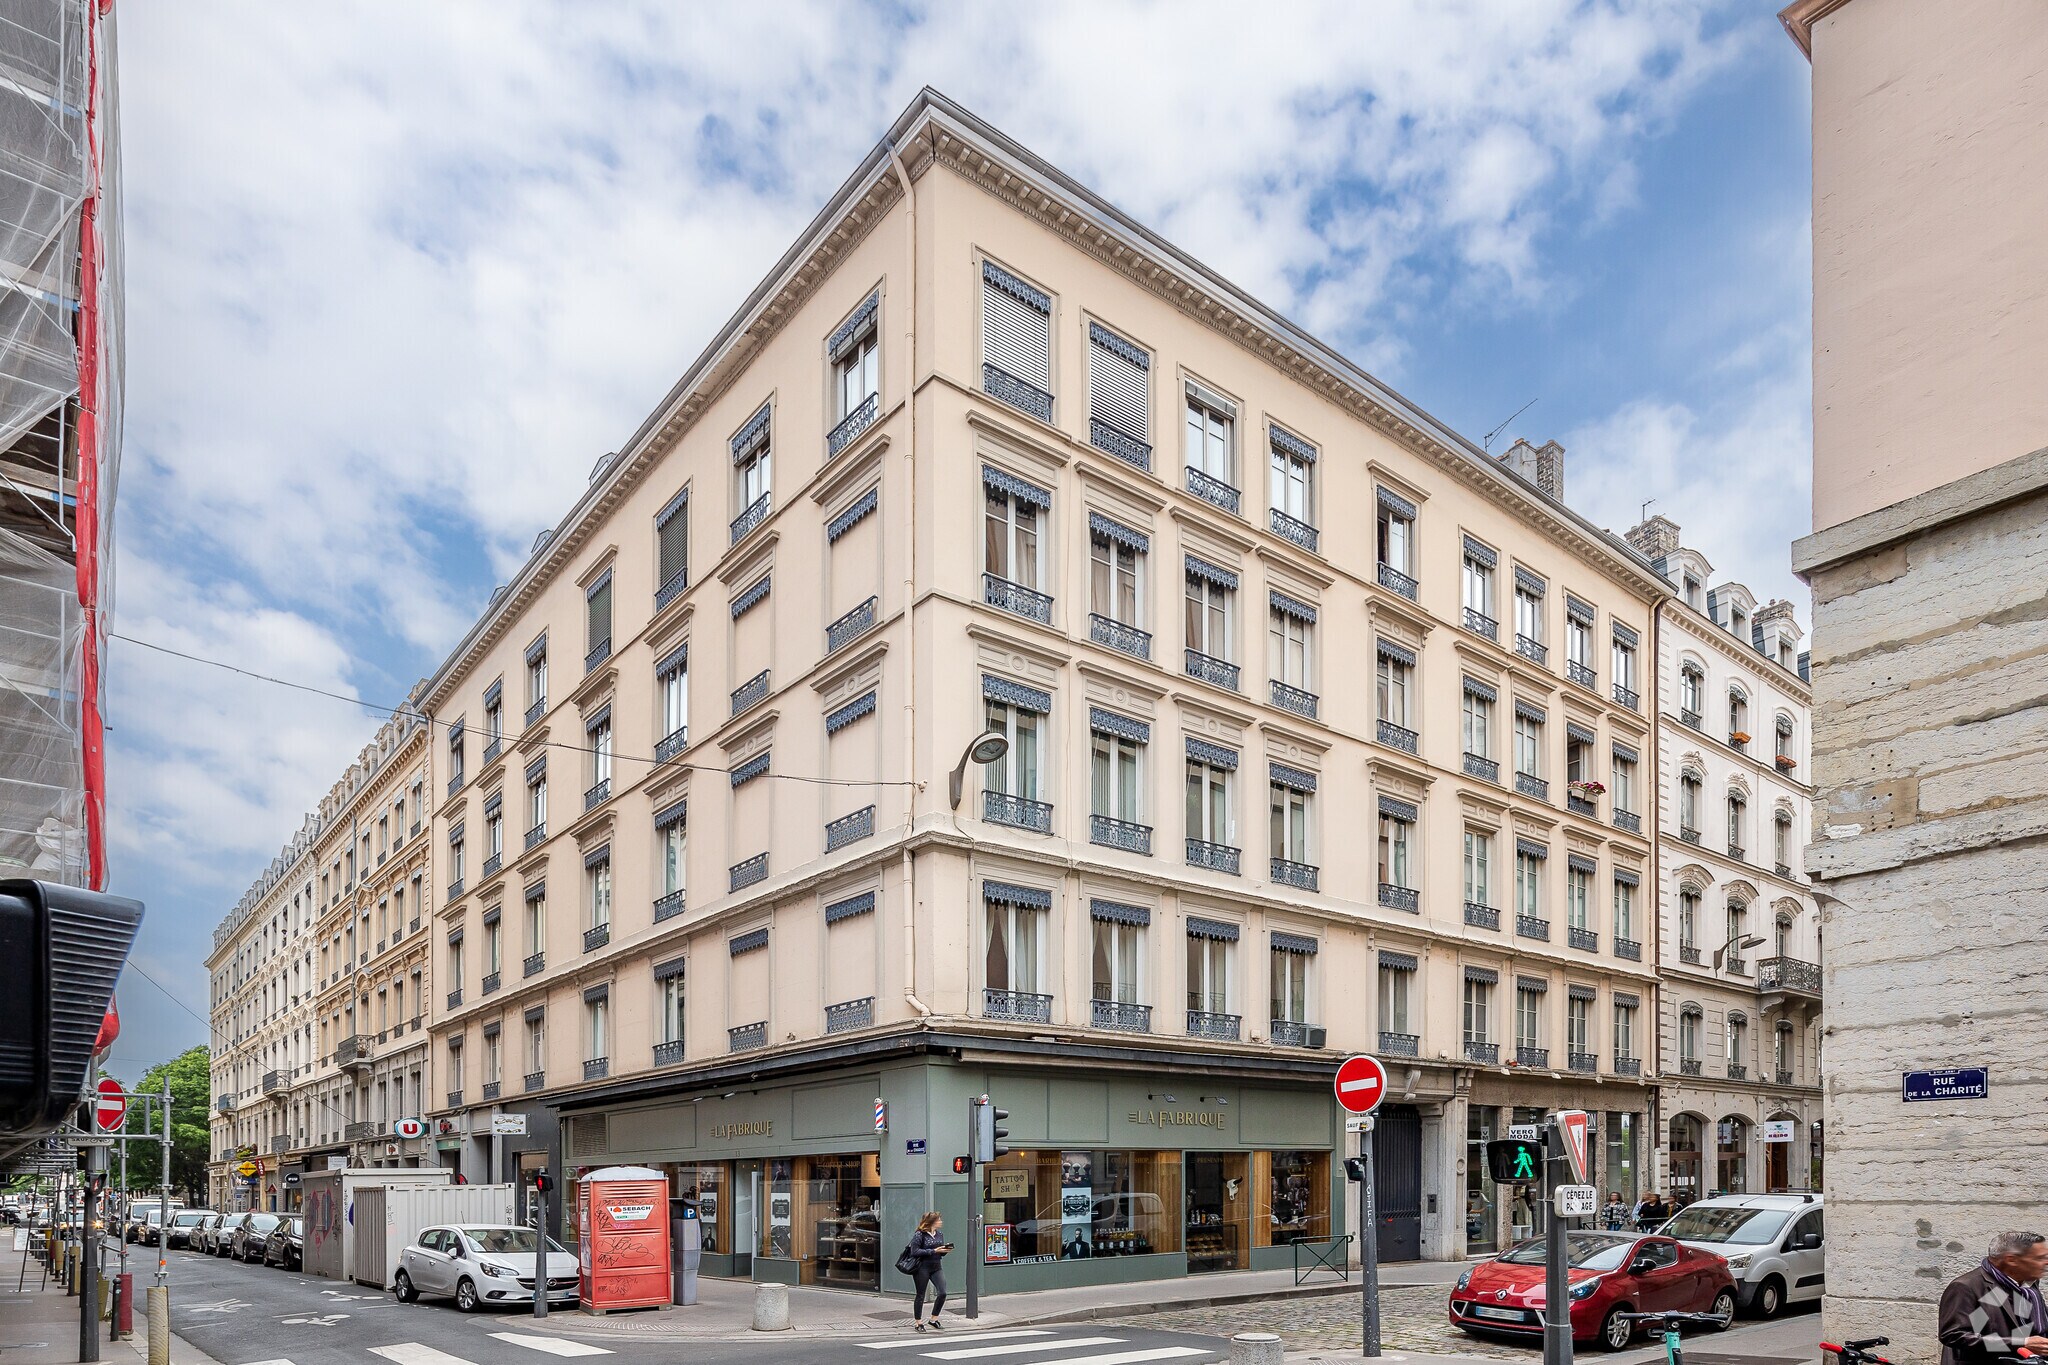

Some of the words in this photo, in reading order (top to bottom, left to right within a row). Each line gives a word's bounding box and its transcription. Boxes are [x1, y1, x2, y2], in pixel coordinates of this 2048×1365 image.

[1933, 1077, 1955, 1086] RUE
[1934, 1084, 1983, 1096] CHARITÉ
[1137, 1109, 1155, 1124] LA
[1159, 1110, 1225, 1130] FABRIQUE
[403, 1123, 418, 1134] U
[715, 1124, 726, 1138] LA
[727, 1120, 774, 1140] FABRIQUE
[994, 1174, 1025, 1184] TATTOO
[1566, 1189, 1584, 1200] CÉDEZ
[1585, 1190, 1593, 1199] LE
[1566, 1201, 1593, 1212] PAAGE
[687, 1208, 695, 1219] P
